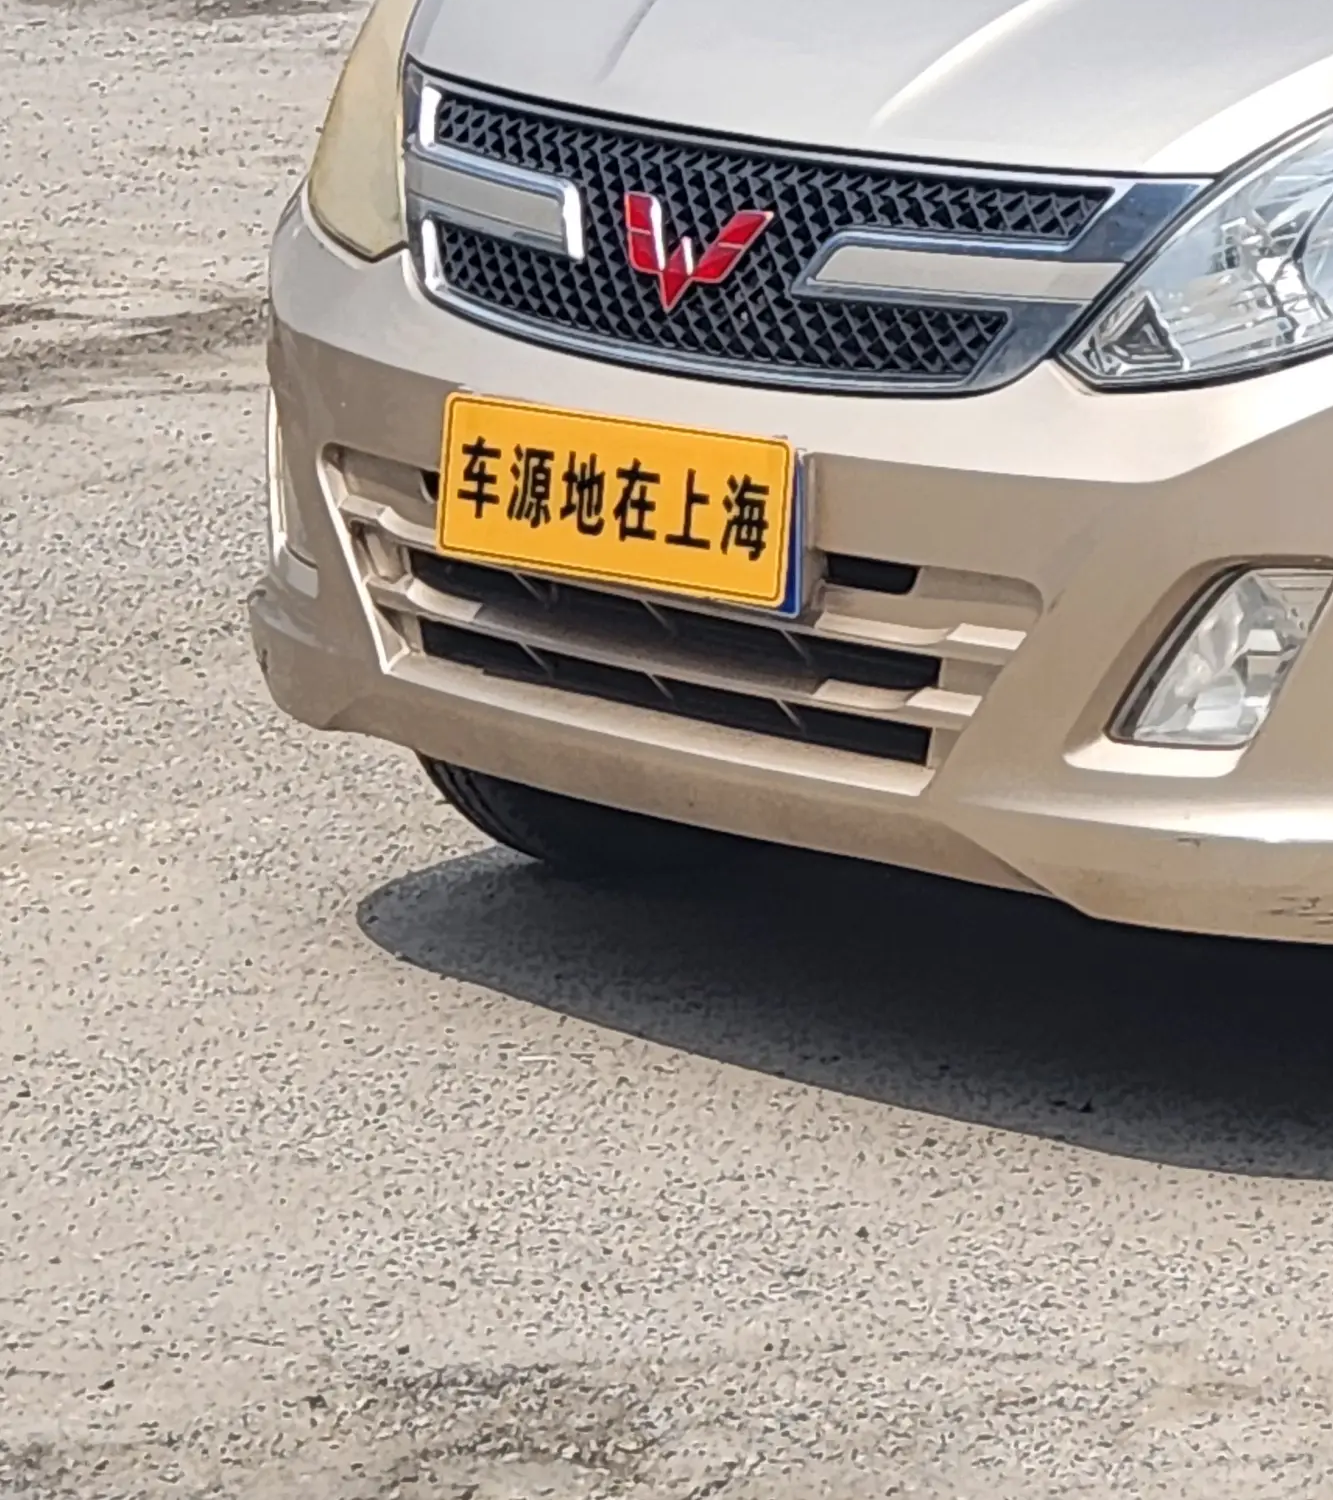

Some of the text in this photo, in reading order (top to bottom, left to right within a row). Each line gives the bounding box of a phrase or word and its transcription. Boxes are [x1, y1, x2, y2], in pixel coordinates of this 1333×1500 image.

[457, 435, 771, 562] 车源地在上海
